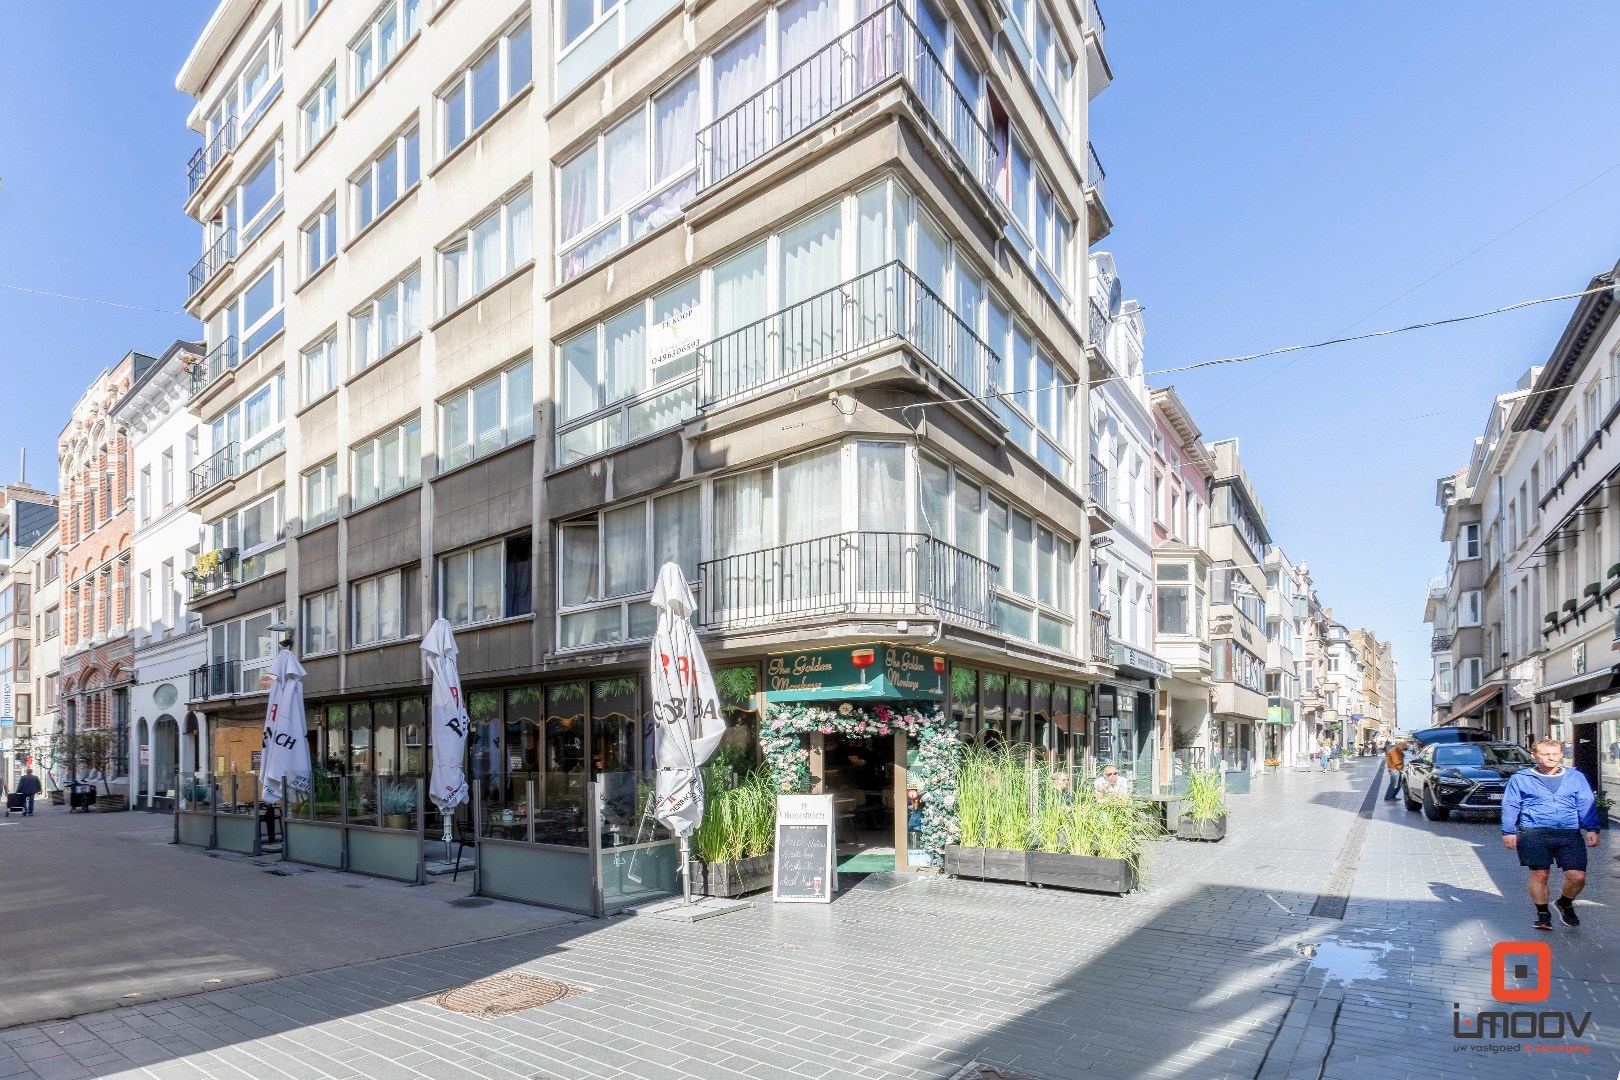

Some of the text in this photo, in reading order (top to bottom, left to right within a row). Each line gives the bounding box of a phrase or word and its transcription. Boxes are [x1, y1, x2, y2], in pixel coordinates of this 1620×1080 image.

[672, 310, 693, 325] KOOP
[768, 655, 833, 676] The Golden
[885, 648, 925, 672] The Golden
